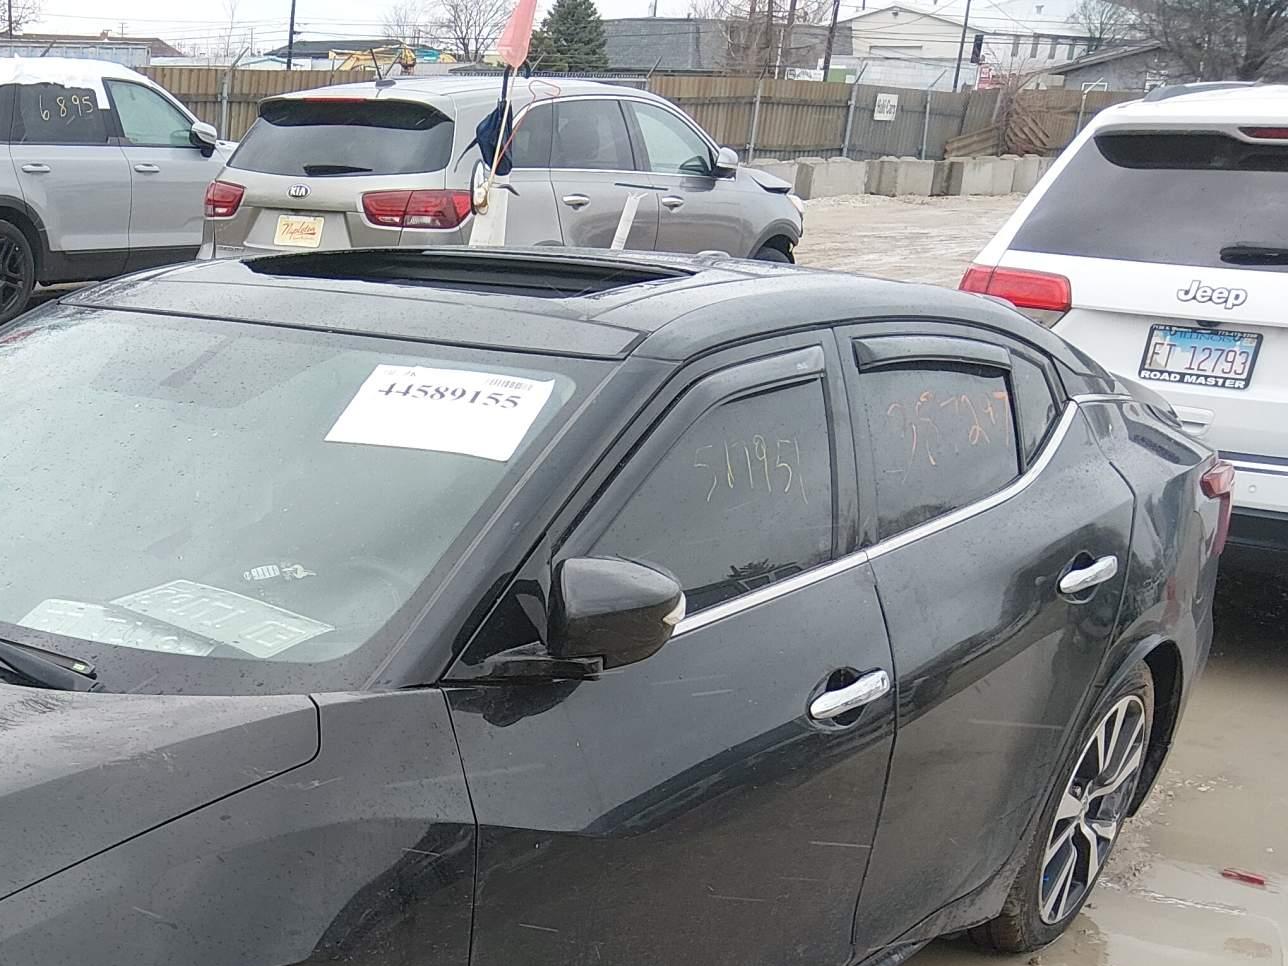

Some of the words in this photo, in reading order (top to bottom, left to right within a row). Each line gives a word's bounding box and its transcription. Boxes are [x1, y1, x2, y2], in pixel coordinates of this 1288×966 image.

[39, 94, 94, 121] 6895
[290, 186, 307, 198] KIA
[1176, 280, 1248, 309] Jeep
[1148, 342, 1177, 368] FT
[1183, 346, 1250, 375] 12793
[1140, 370, 1181, 381] ROAD
[1183, 375, 1246, 389] MASTER
[377, 382, 522, 409] 44589155
